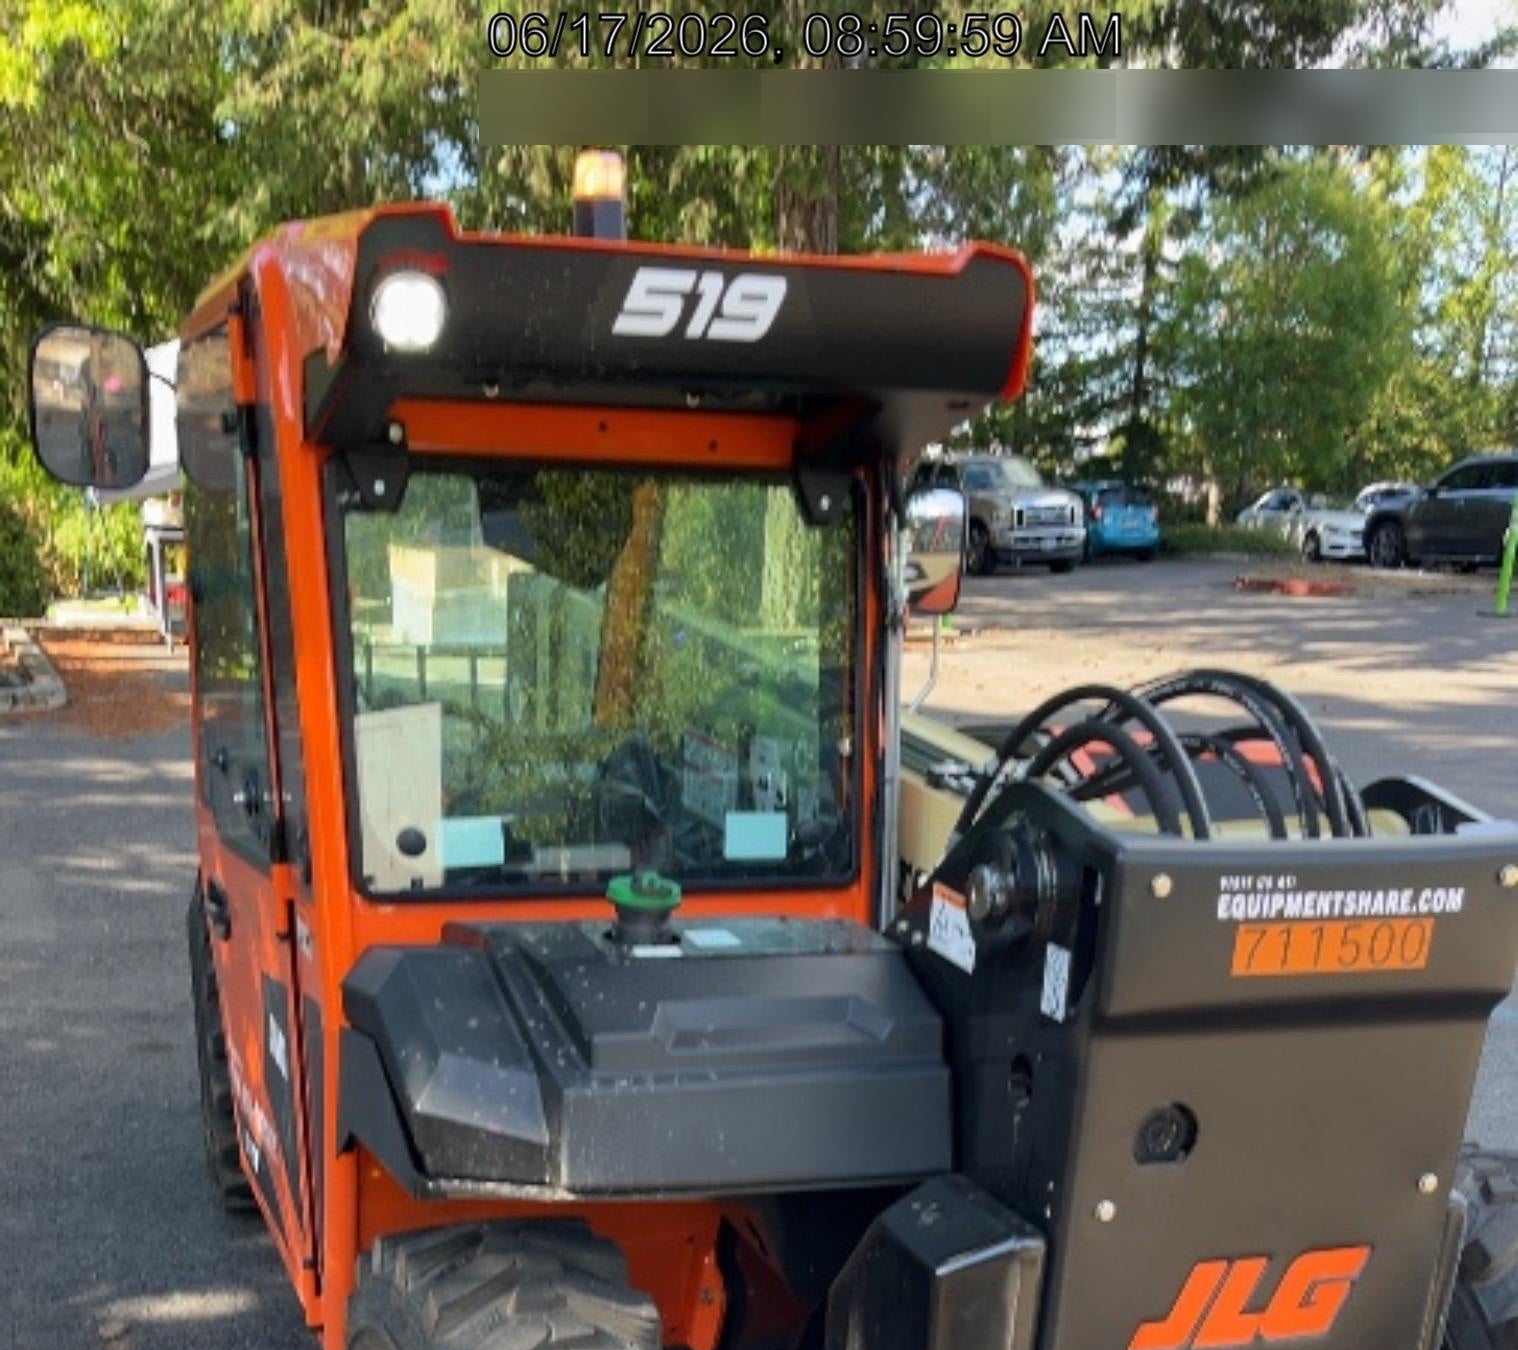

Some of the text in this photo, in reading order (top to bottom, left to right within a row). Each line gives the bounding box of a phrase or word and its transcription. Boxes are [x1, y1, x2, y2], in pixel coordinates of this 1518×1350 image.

[611, 266, 787, 343] 519
[1217, 887, 1465, 920] EQUIPMENTSHARE.COM
[1243, 922, 1427, 969] 711500
